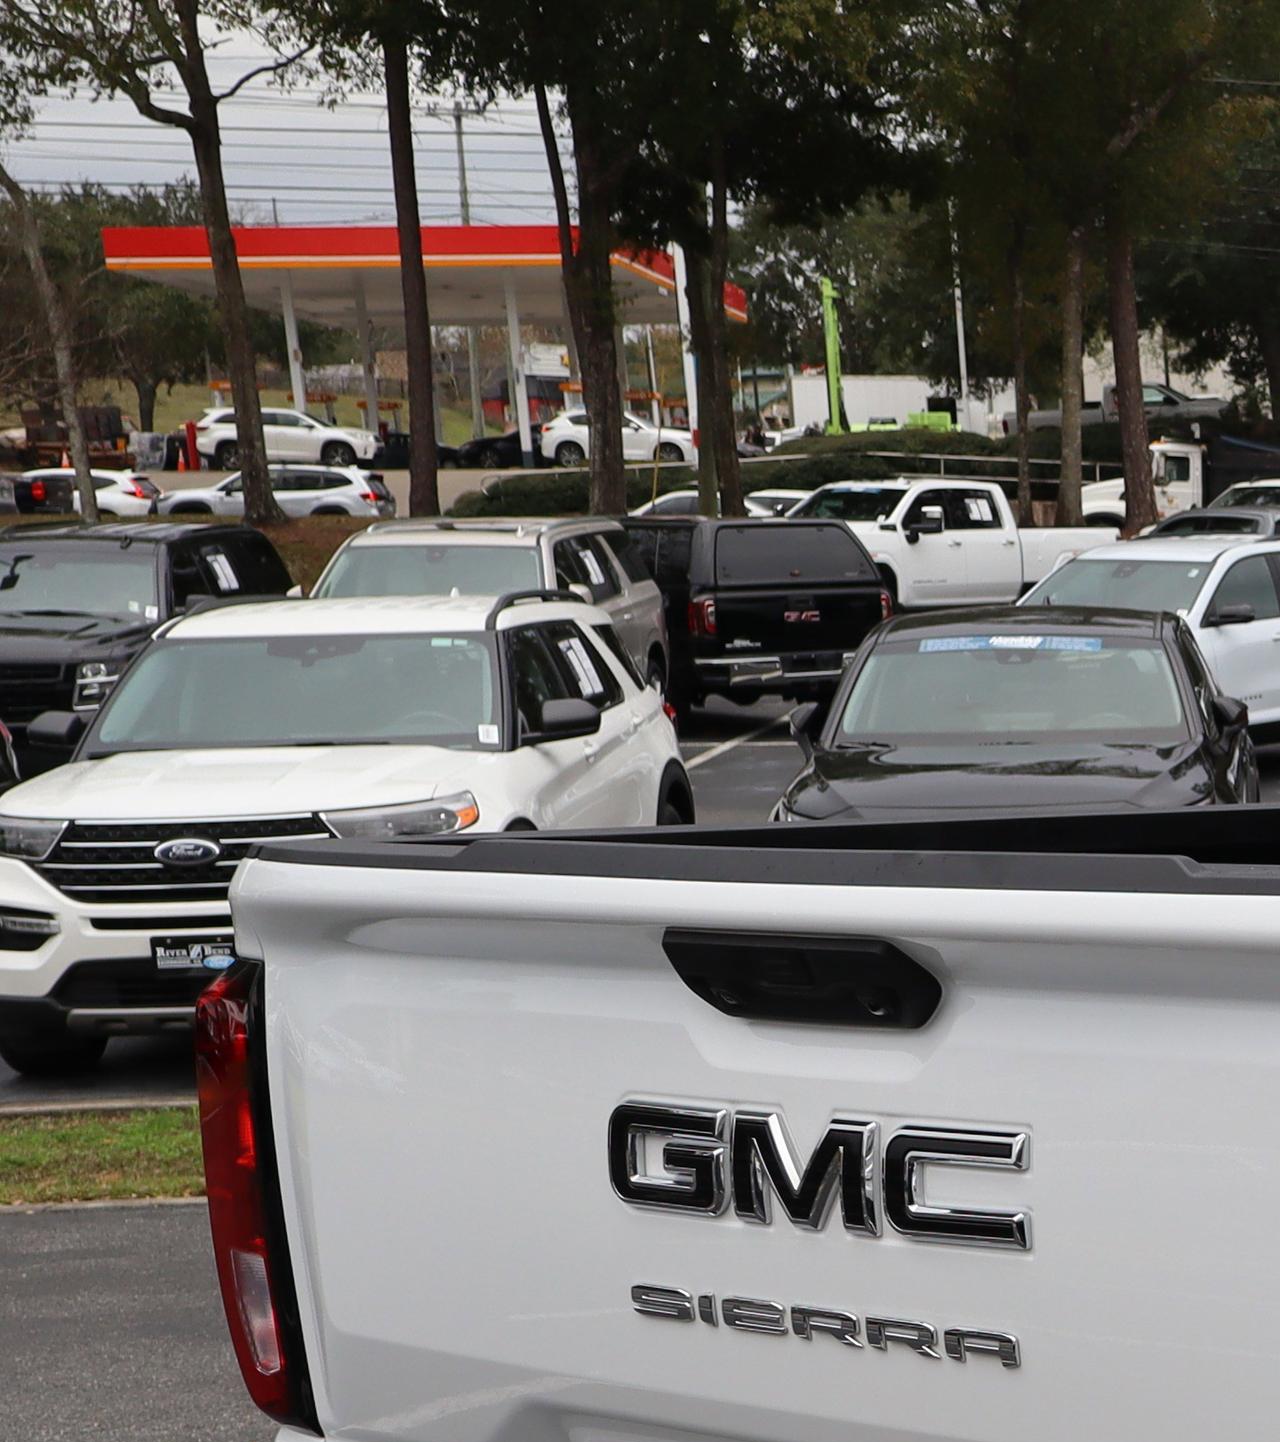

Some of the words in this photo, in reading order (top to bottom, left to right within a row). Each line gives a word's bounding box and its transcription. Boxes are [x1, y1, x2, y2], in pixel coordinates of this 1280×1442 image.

[155, 946, 187, 957] RIVER
[204, 944, 231, 955] BEND
[608, 1096, 1034, 1251] GMC
[631, 1284, 1023, 1369] SIERRA
